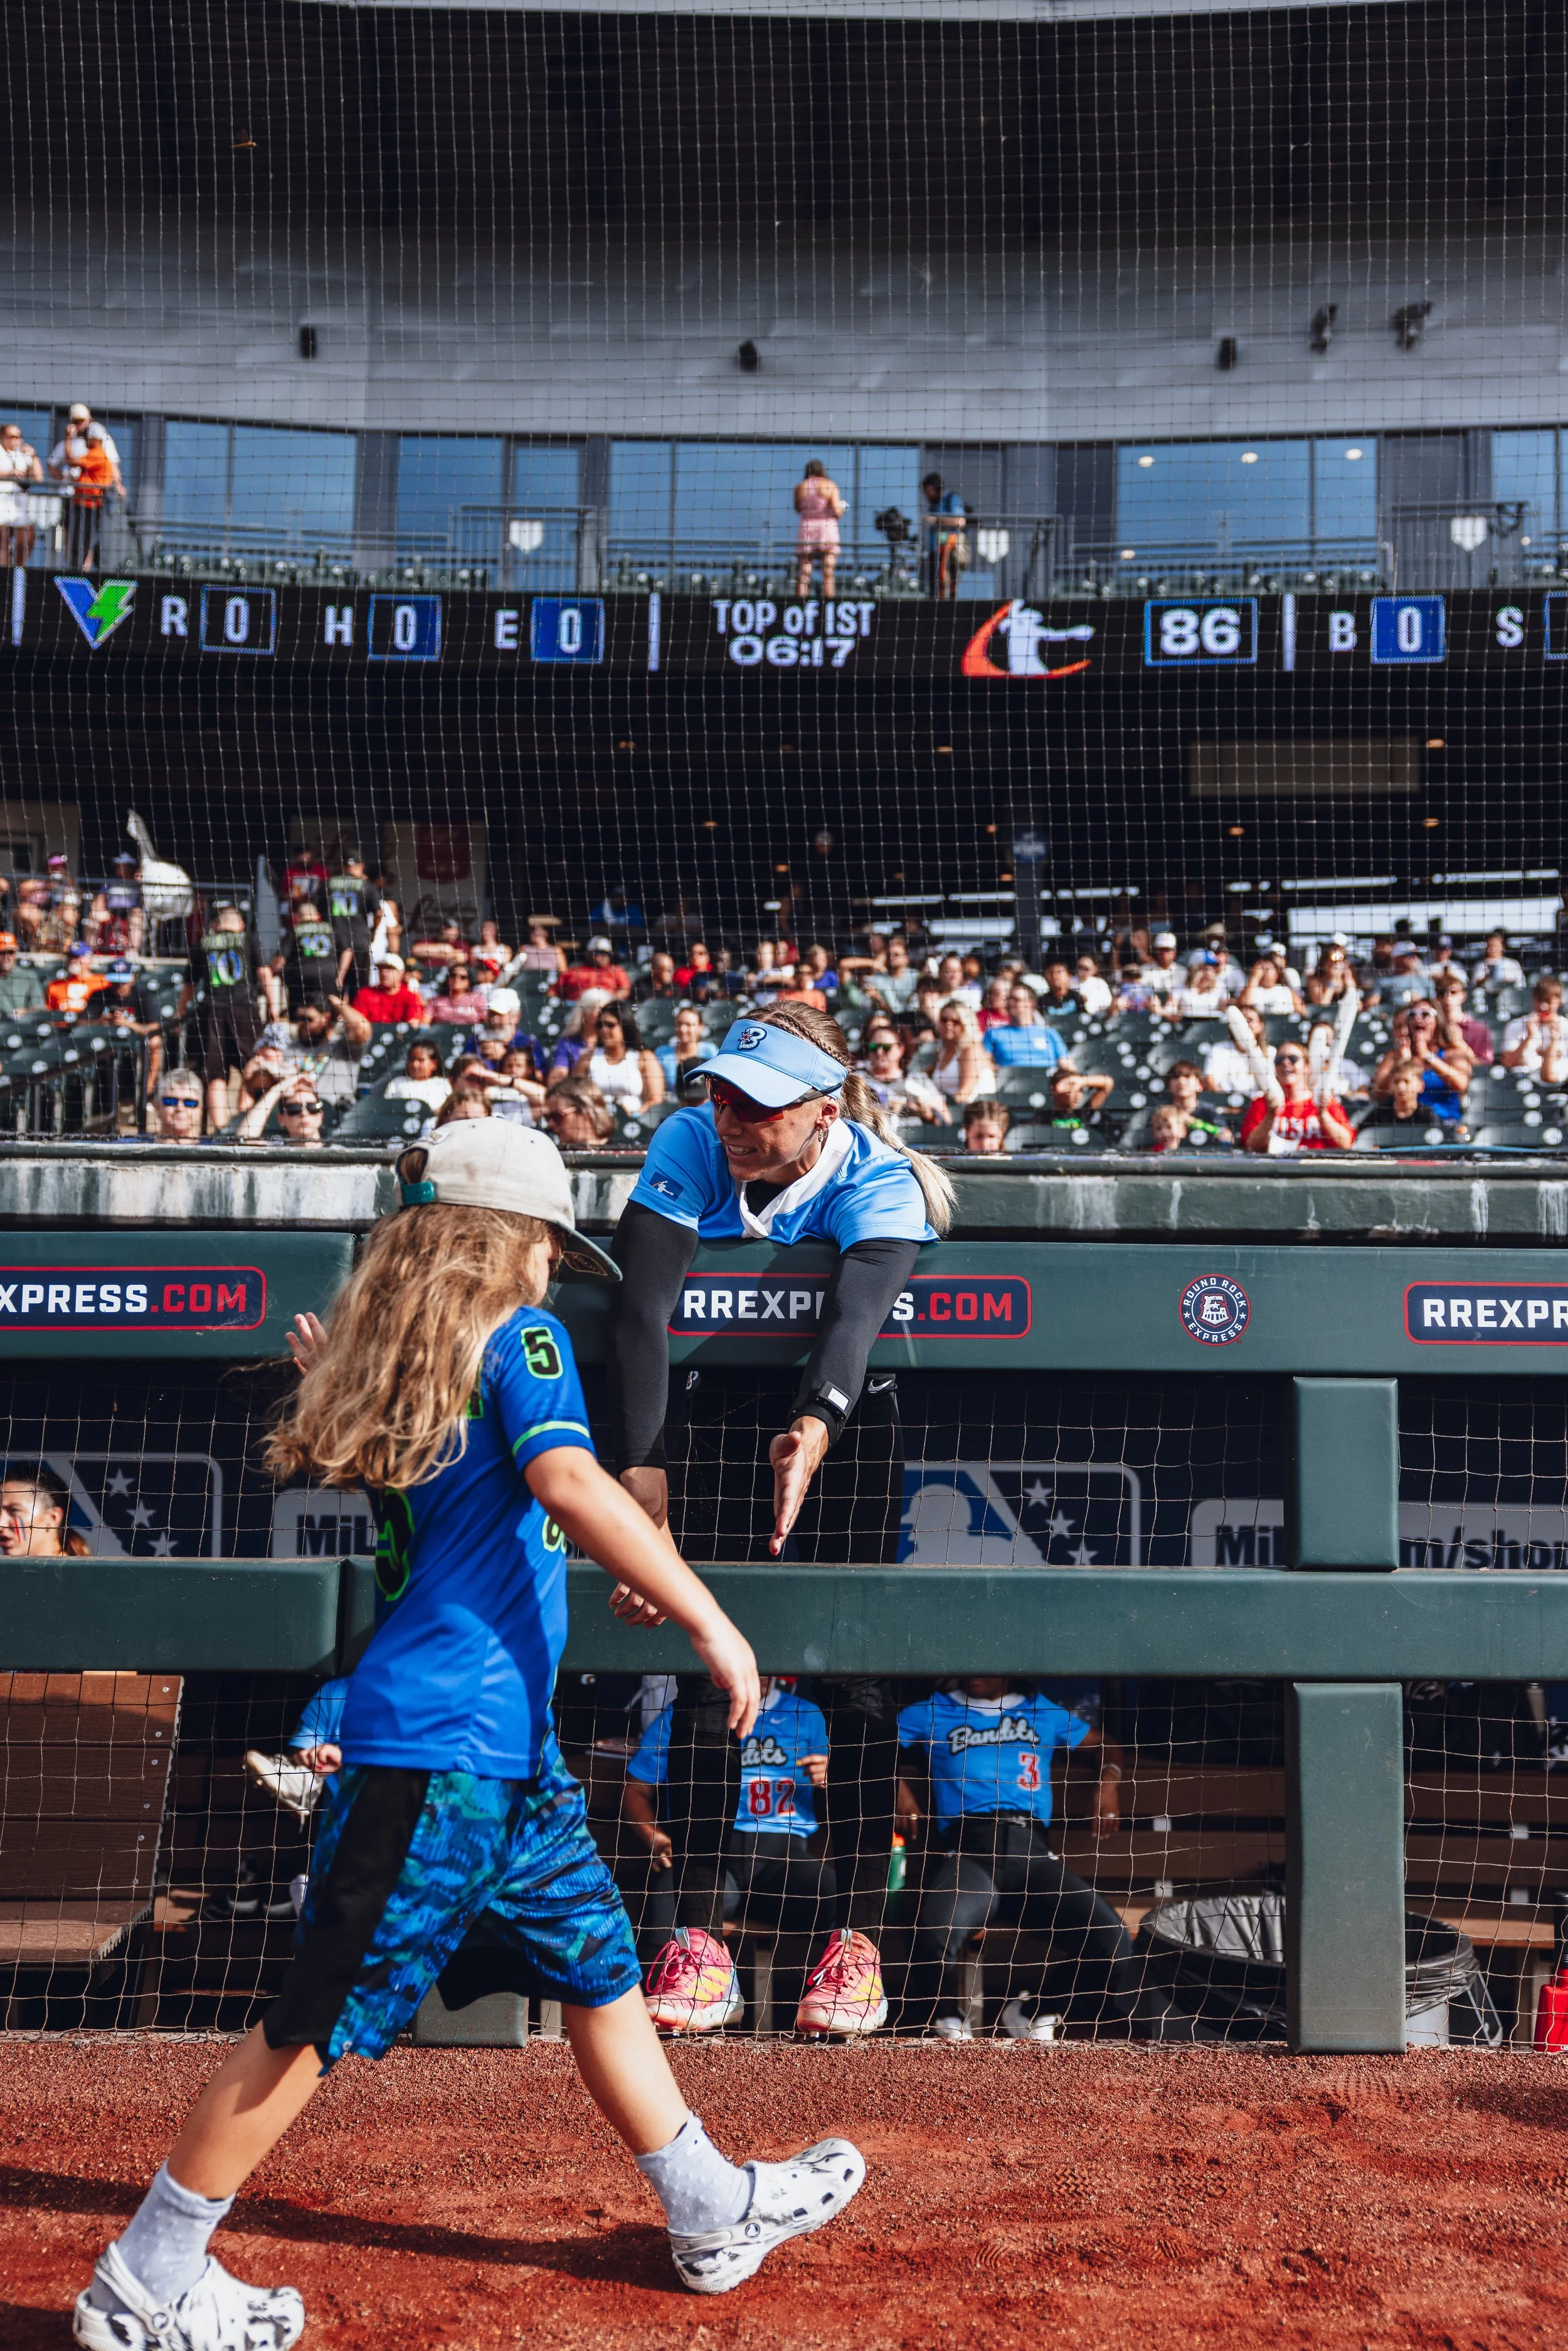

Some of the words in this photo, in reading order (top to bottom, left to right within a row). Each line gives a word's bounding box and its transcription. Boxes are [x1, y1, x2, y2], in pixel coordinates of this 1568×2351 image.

[161, 595, 188, 637] R
[225, 596, 250, 643] 0
[324, 605, 353, 646] H
[394, 605, 418, 651] 0
[495, 608, 519, 650] E
[559, 608, 582, 654] 0
[712, 599, 778, 635] TOP
[1160, 608, 1241, 655] 86
[1329, 610, 1358, 652] B
[1397, 606, 1421, 653] 0
[1496, 606, 1524, 647] S
[728, 634, 856, 667] 06:17
[208, 949, 244, 987] 10
[1271, 1115, 1322, 1140] USA
[1183, 1277, 1217, 1307] ROUND
[1221, 1279, 1247, 1308] ROCK
[1188, 1322, 1242, 1342] EXPRESS
[521, 1326, 563, 1380] 5
[948, 1716, 1041, 1756] Bandits
[1017, 1751, 1042, 1792] 3
[748, 1776, 797, 1817] 82
